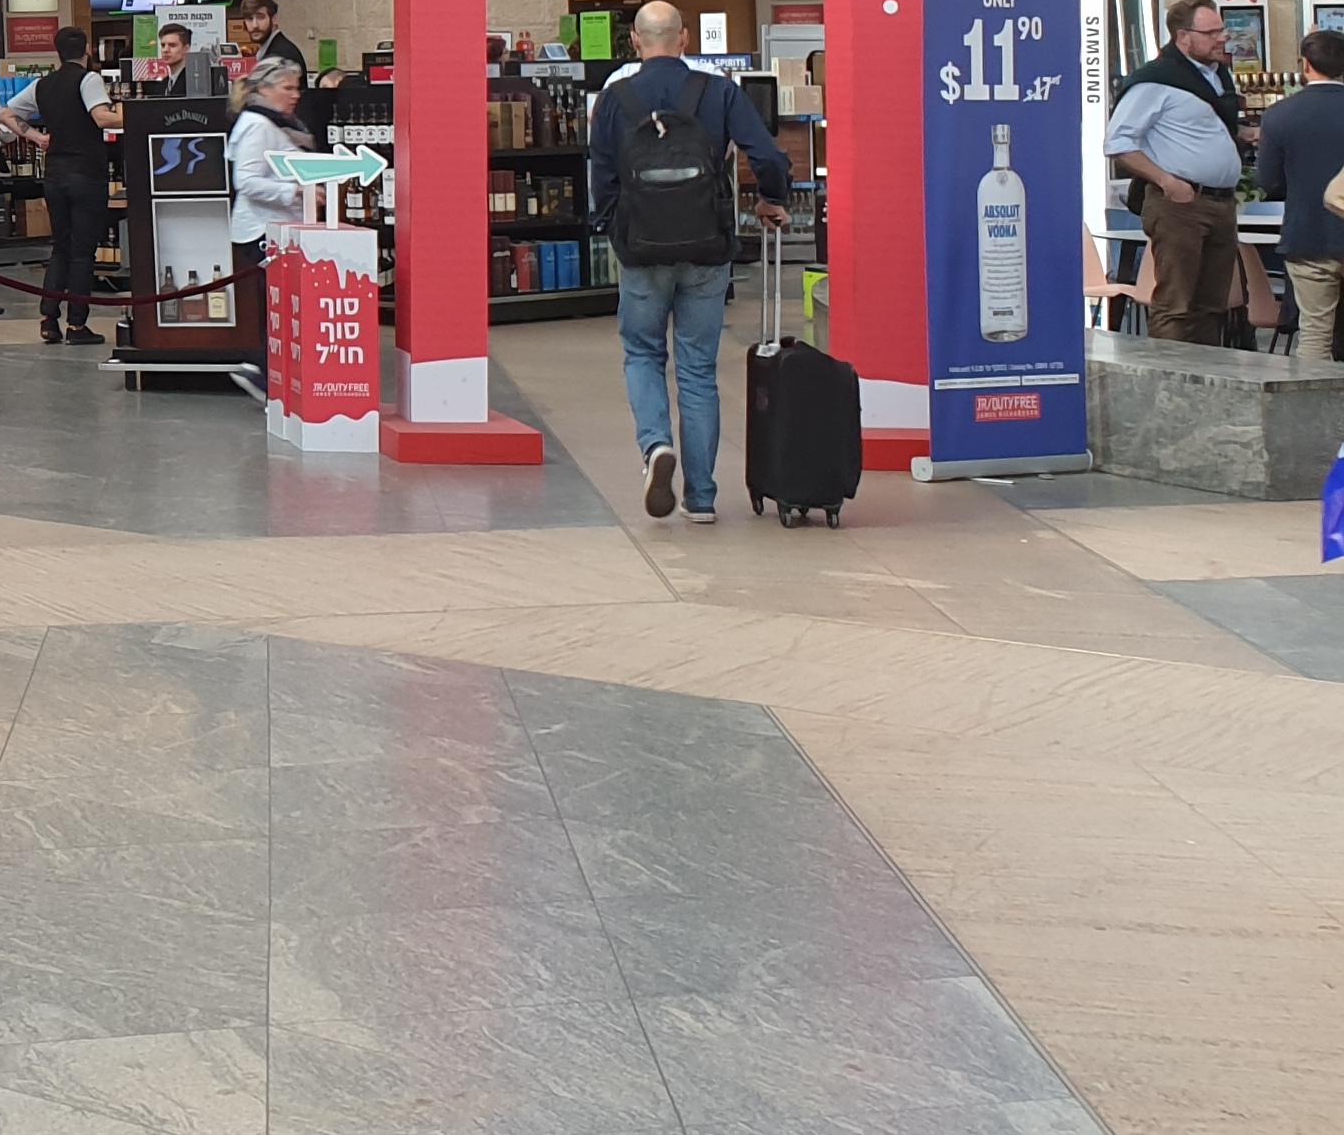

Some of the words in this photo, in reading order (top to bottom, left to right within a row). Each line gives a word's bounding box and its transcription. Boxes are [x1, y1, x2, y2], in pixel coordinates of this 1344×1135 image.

[1085, 16, 1100, 103] SAMSUNG
[984, 205, 1020, 218] ABSOLUT
[987, 224, 1017, 238] VODKA
[320, 298, 359, 319] סוף
[320, 322, 359, 343] סוף
